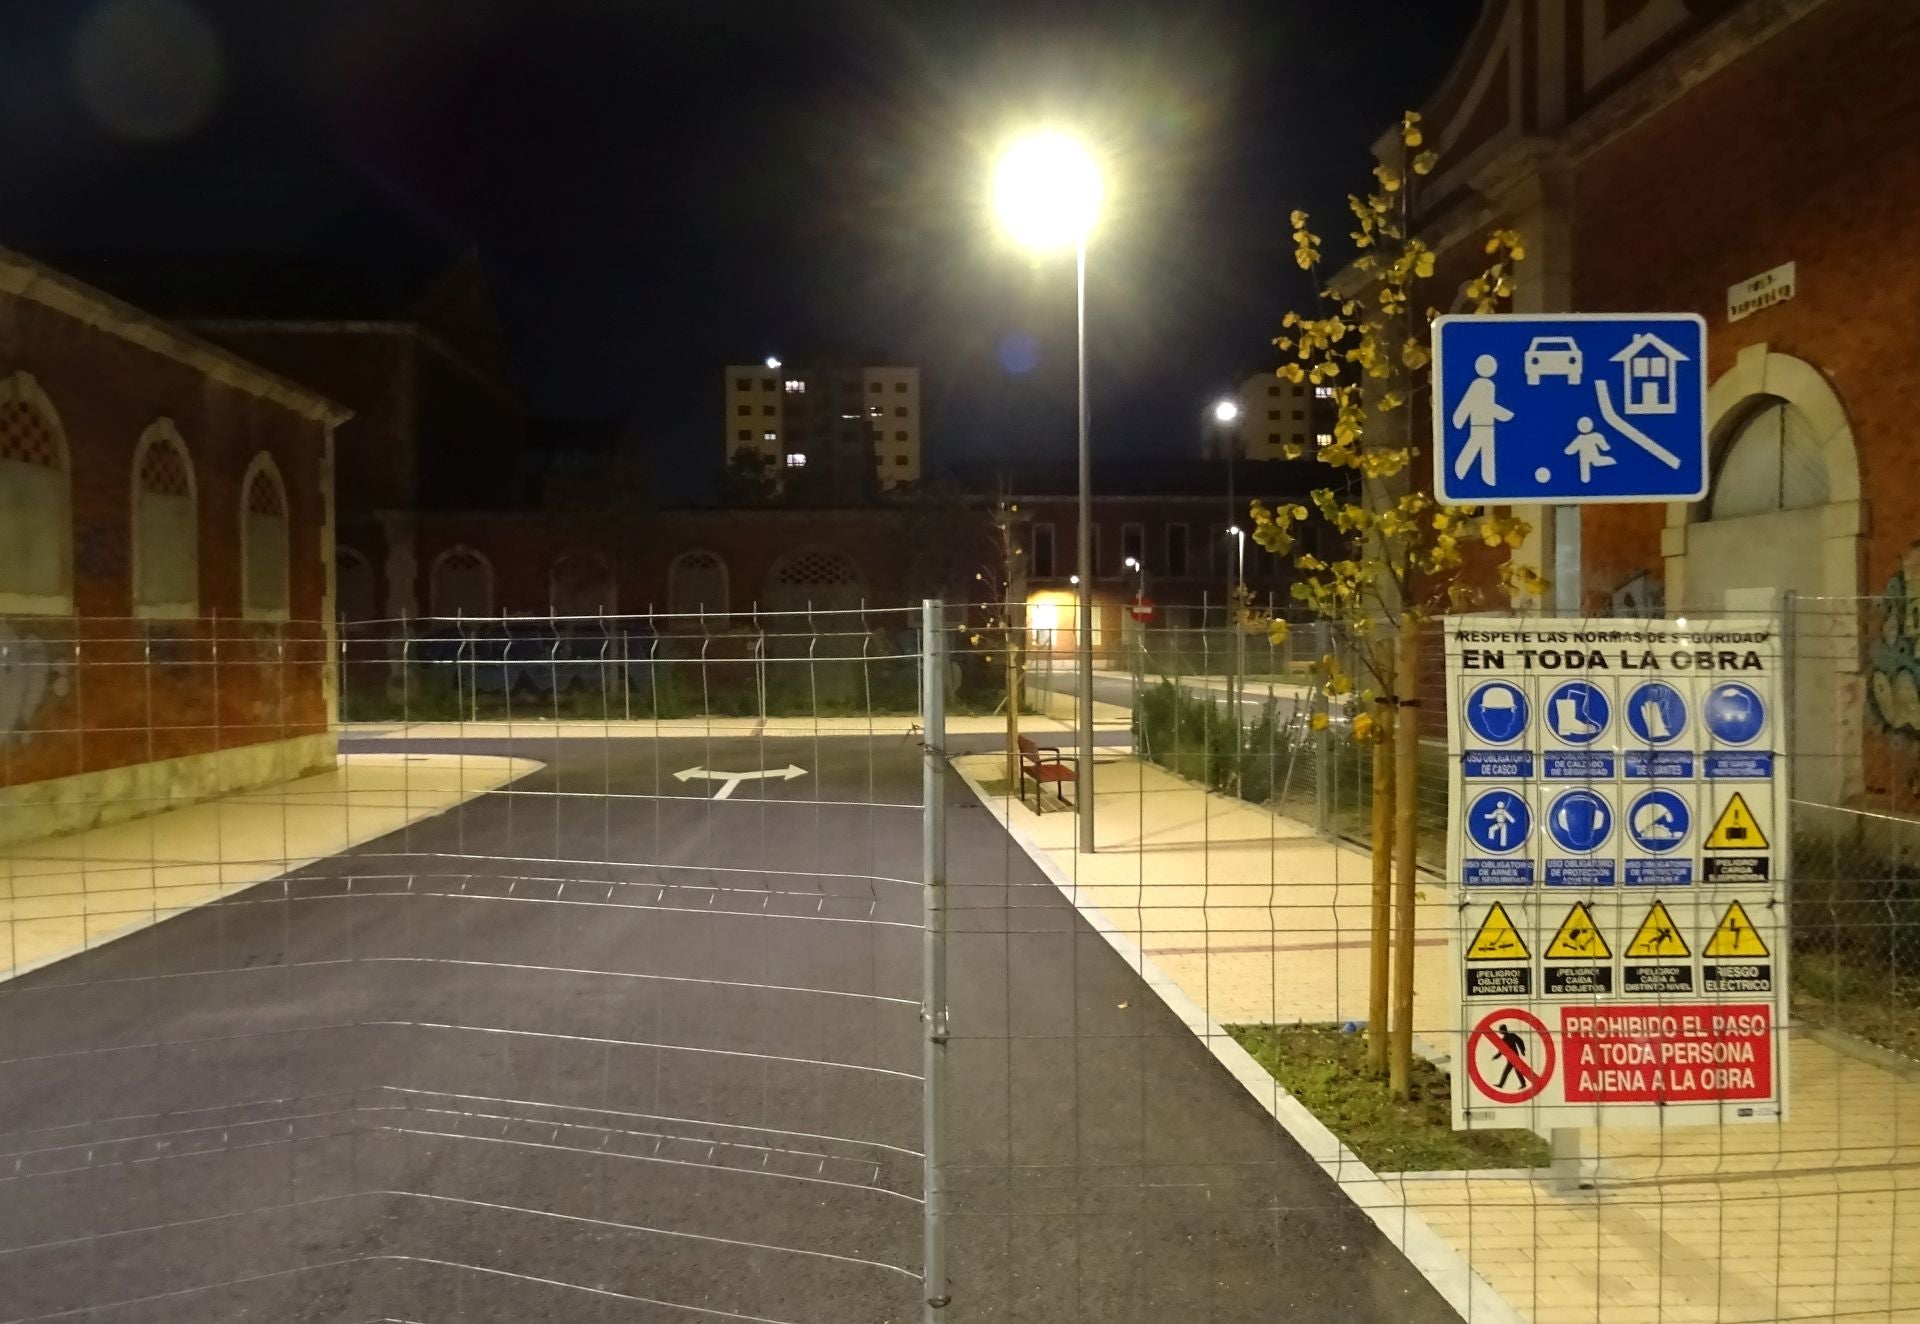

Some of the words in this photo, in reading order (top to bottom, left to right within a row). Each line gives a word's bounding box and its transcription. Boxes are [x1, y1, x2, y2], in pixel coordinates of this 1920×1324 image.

[1461, 631, 1532, 643] RESPETE
[1537, 632, 1568, 643] LAS
[1574, 632, 1643, 643] NORMAS
[1648, 632, 1666, 643] DE
[1463, 649, 1505, 669] EN
[1516, 649, 1609, 669] TODA
[1620, 650, 1660, 670] LA
[1671, 650, 1763, 670] OBRA
[1481, 764, 1492, 775] DE
[1491, 764, 1518, 775] CASCO
[1476, 970, 1521, 978] ¡PELIGRO!
[1716, 966, 1760, 977] RIESGO
[1472, 985, 1526, 993] PUNZANTES
[1551, 984, 1563, 992] DE
[1564, 984, 1606, 992] OBJETOS
[1566, 1016, 1677, 1039] PROHIBIDO
[1682, 1016, 1708, 1038] EL
[1712, 1015, 1766, 1037] PASO
[1580, 1044, 1595, 1066] A
[1599, 1043, 1656, 1065] TODA
[1661, 1041, 1755, 1064] PERSONA
[1579, 1070, 1647, 1092] AJENA
[1651, 1070, 1666, 1091] A
[1670, 1069, 1696, 1090] LA
[1700, 1068, 1756, 1090] OBRA
